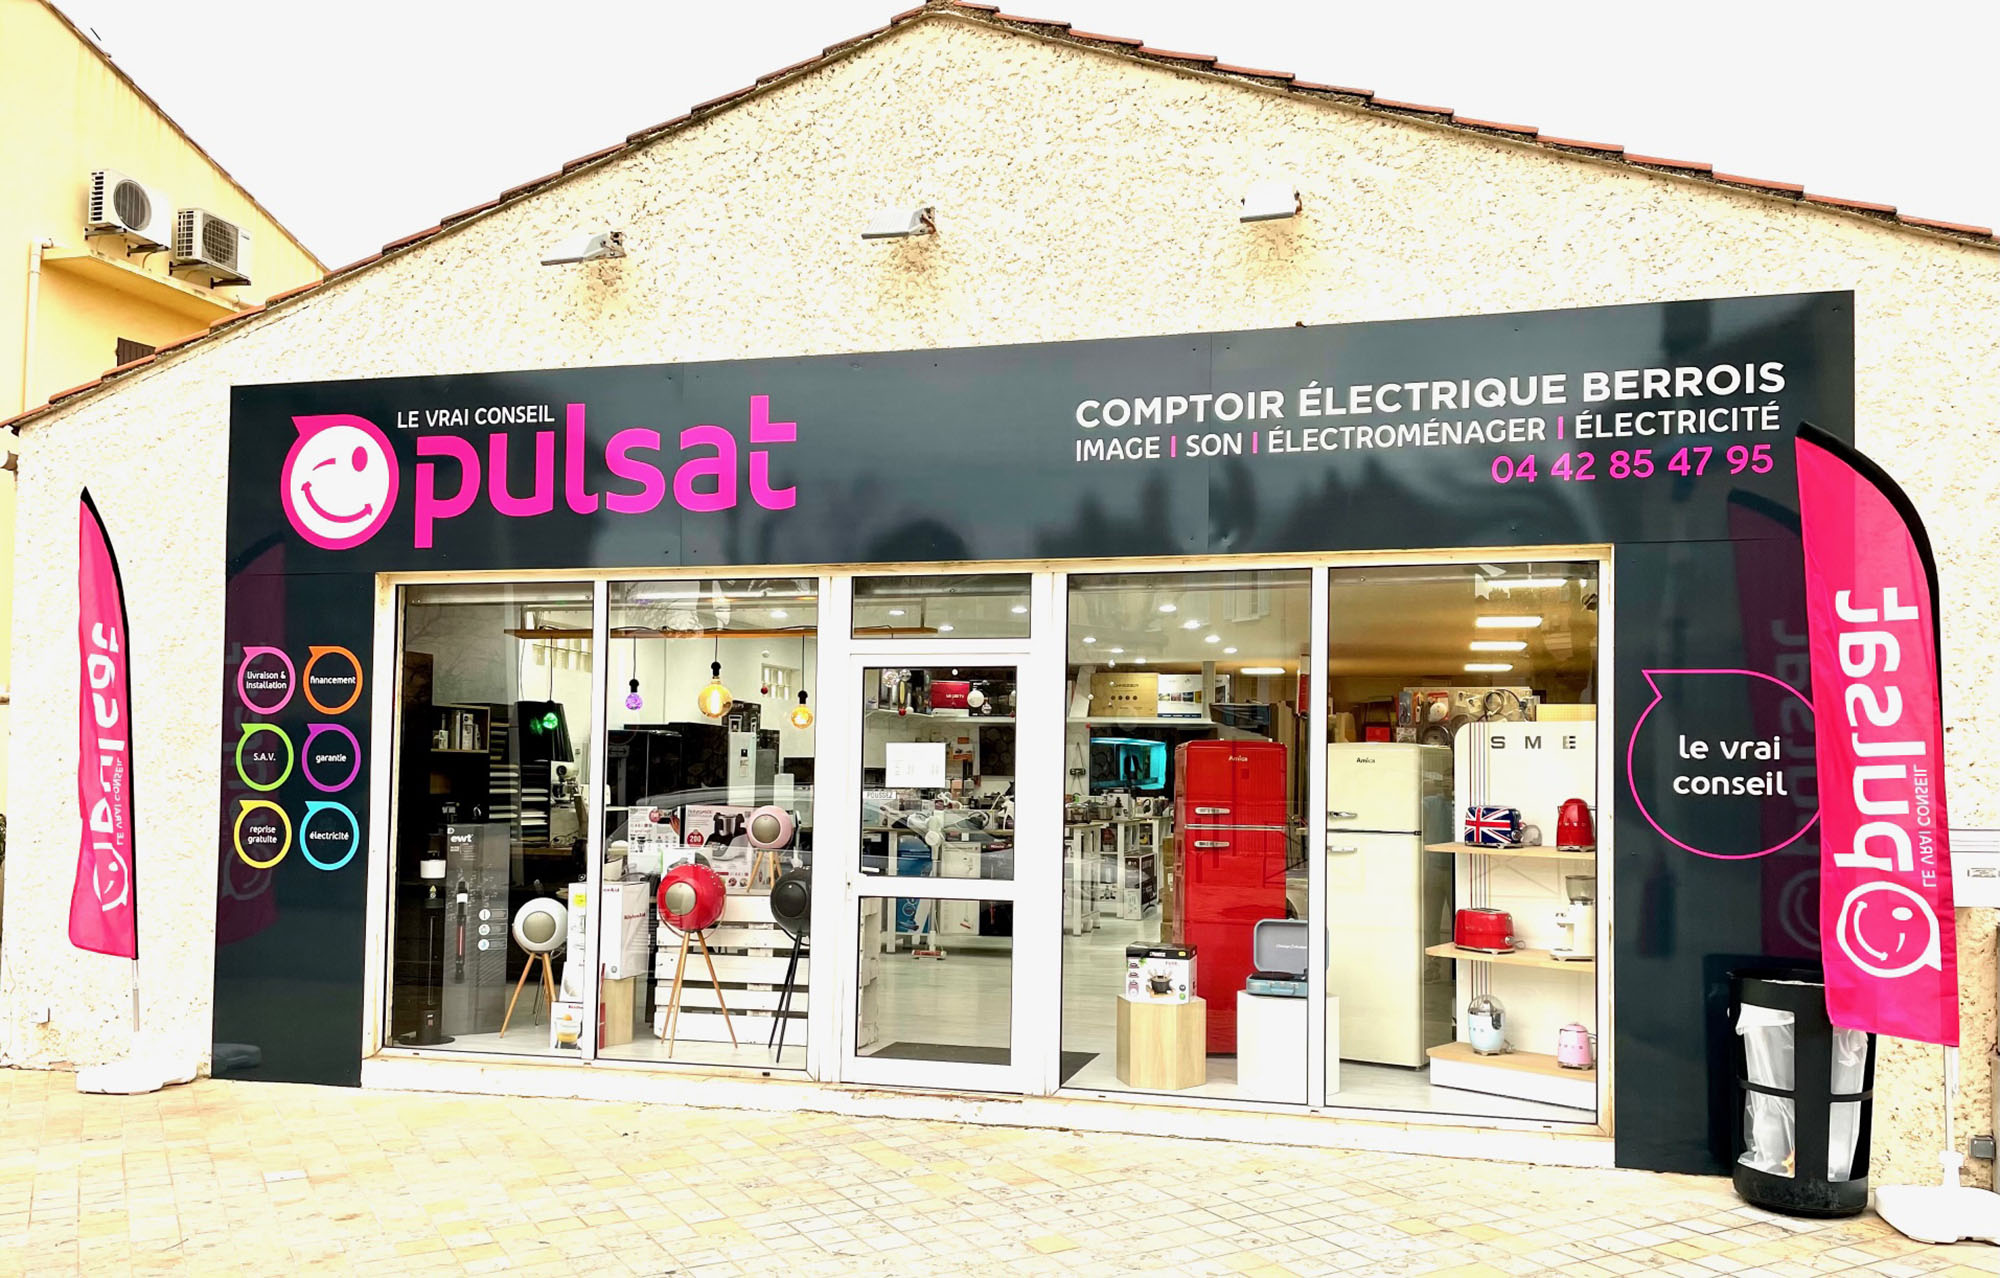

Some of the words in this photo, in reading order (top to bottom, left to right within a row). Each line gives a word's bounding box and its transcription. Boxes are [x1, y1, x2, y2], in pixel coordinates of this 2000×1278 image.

[1075, 390, 1285, 429] COMPTOIR
[1299, 371, 1567, 418] ÉLECTRIQUE
[1583, 362, 1785, 402] BERROIS
[397, 411, 419, 429] LE
[425, 408, 469, 428] VRAI
[474, 404, 555, 425] CONSEIL
[1076, 436, 1161, 462] IMAGE
[1185, 432, 1243, 458] SON
[1267, 415, 1546, 454] ÉLECTROMÉNAGER
[1575, 400, 1780, 440] ÉLECTRICITÉ
[1491, 454, 1538, 484] 04
[1550, 451, 1597, 482] 42
[1608, 449, 1655, 480] 85
[1667, 446, 1713, 477] 47
[1725, 443, 1774, 475] 95
[413, 394, 797, 549] pulsat
[246, 671, 279, 680] livraison
[280, 670, 287, 680] &
[309, 675, 356, 685] financement
[245, 681, 287, 690] installation
[1679, 734, 1709, 760] le
[1719, 736, 1781, 760] vrai
[253, 752, 276, 761] S.A.V.
[315, 753, 347, 764] garantie
[1672, 770, 1788, 796] conseil
[249, 825, 277, 835] reprise
[247, 834, 278, 845] gratuite
[309, 831, 350, 841] électricité
